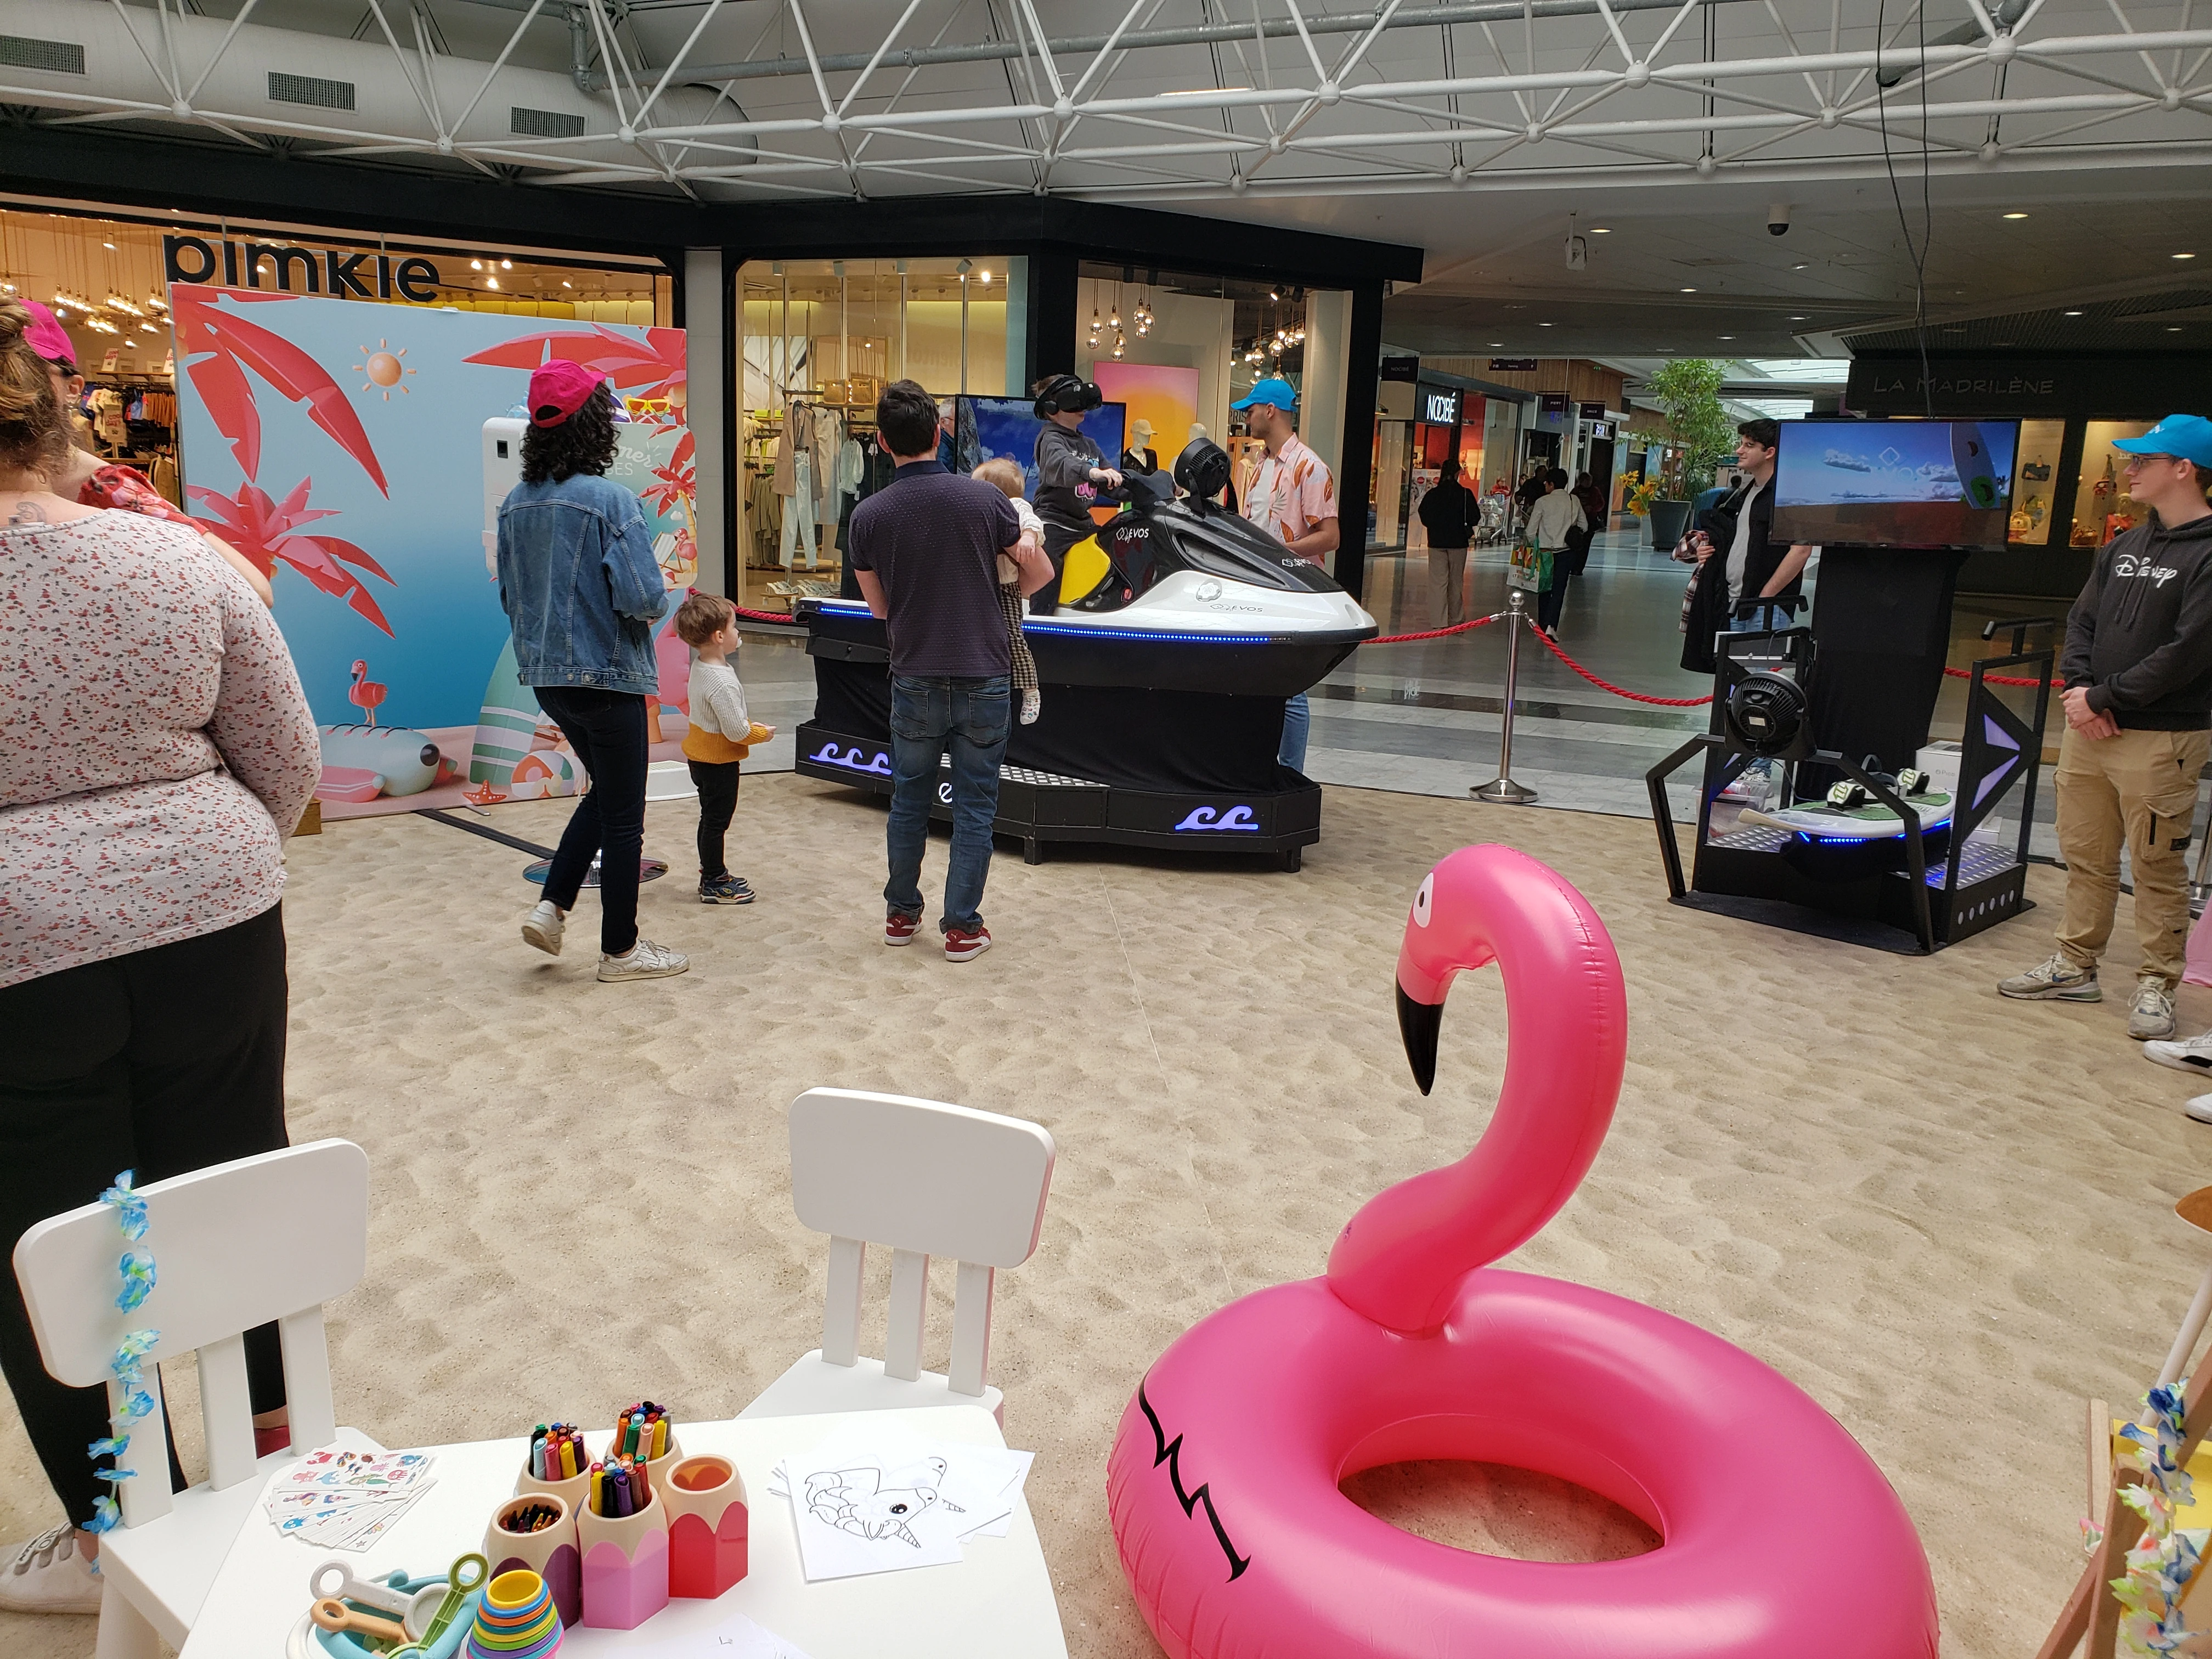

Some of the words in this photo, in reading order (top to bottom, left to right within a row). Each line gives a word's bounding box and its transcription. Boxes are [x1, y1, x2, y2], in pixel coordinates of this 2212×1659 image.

[161, 234, 440, 303] pimkie
[1873, 377, 1905, 393] LA
[1916, 376, 2054, 394] MADRILÈNE
[1426, 392, 1456, 423] NOCIBÉ
[1129, 528, 1149, 538] EVOS
